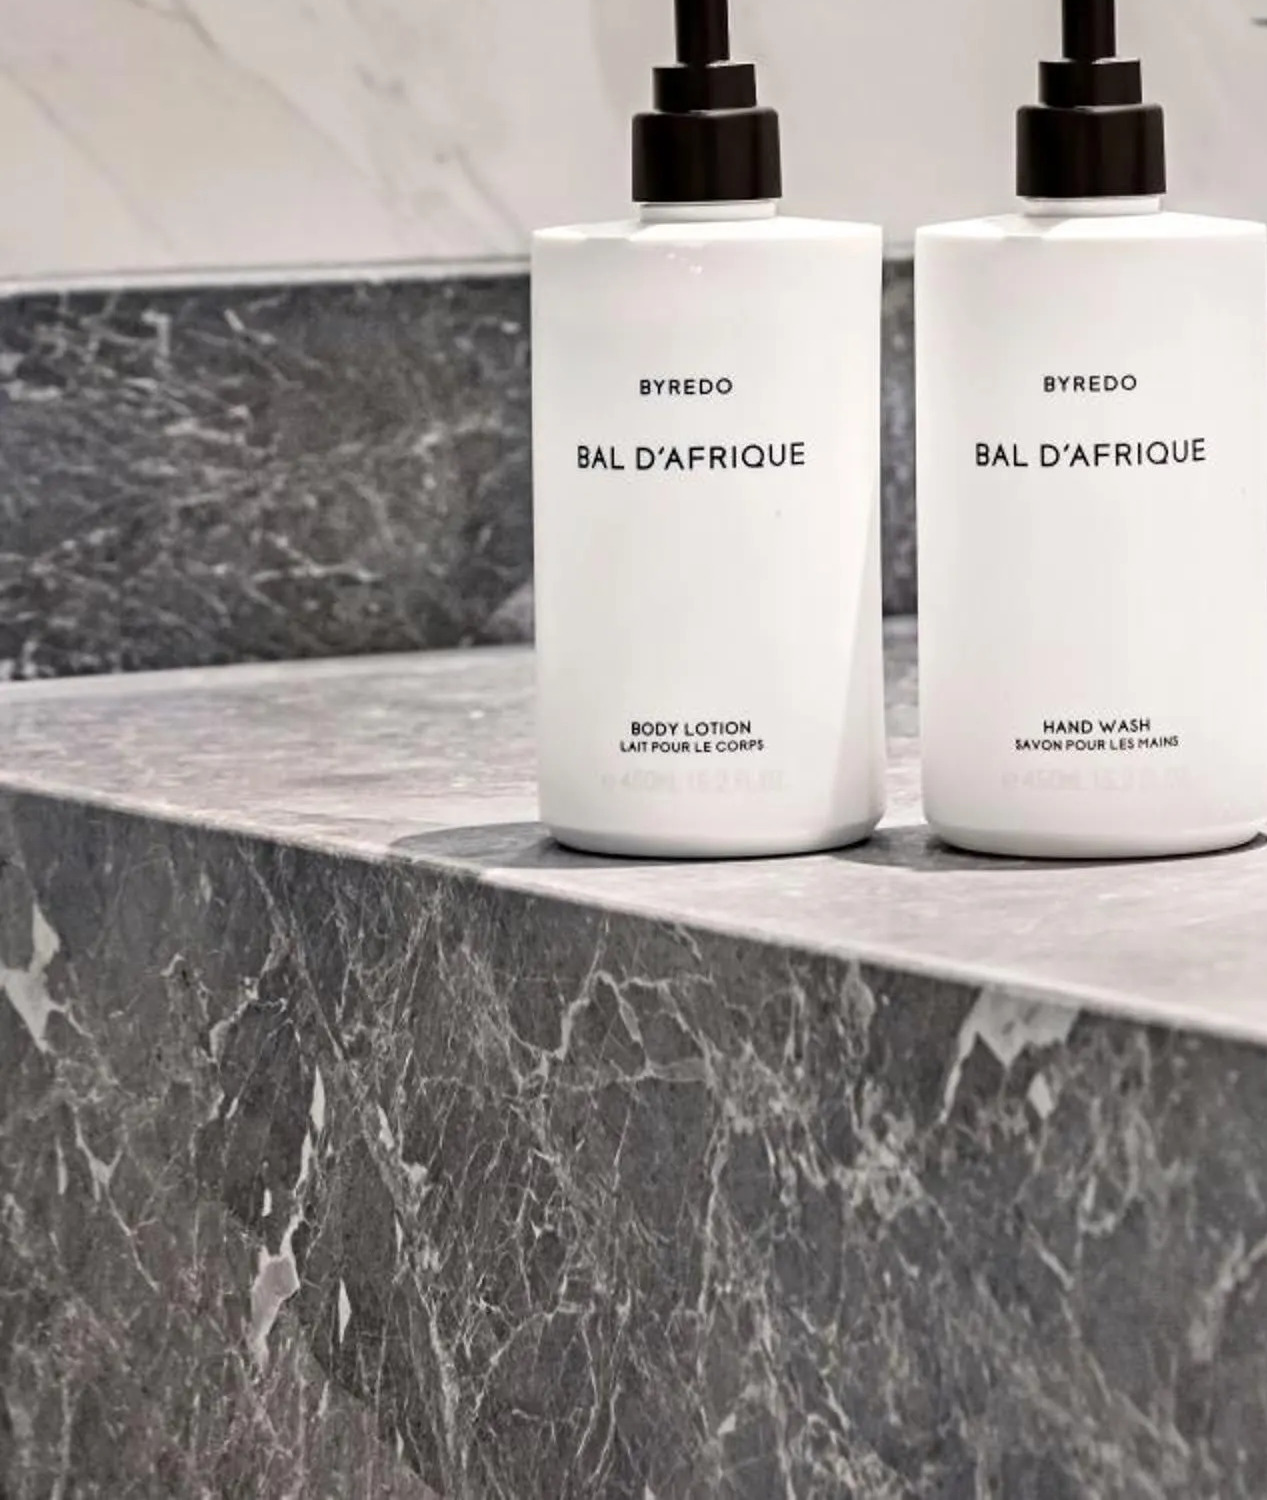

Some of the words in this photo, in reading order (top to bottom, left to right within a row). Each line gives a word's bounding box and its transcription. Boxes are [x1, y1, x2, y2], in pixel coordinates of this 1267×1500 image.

[640, 377, 733, 396] BYREDO
[1043, 374, 1137, 393] BYREDO
[577, 444, 625, 471] BAL
[635, 442, 806, 471] D'AFRIQUE
[975, 442, 1029, 468] BAL
[1039, 437, 1206, 468] D'AFRIQUE
[631, 721, 679, 737] BODY
[684, 720, 752, 737] LOTION
[1043, 719, 1093, 734] HAND
[1099, 718, 1151, 734] WASH
[620, 741, 648, 753] LAIT
[651, 741, 690, 753] POUR
[695, 742, 712, 753] LE
[715, 739, 765, 753] CORPS
[1015, 738, 1063, 752] SAVON
[1065, 739, 1106, 751] POUR
[1110, 738, 1135, 751] LES
[1138, 735, 1179, 749] MAINS
